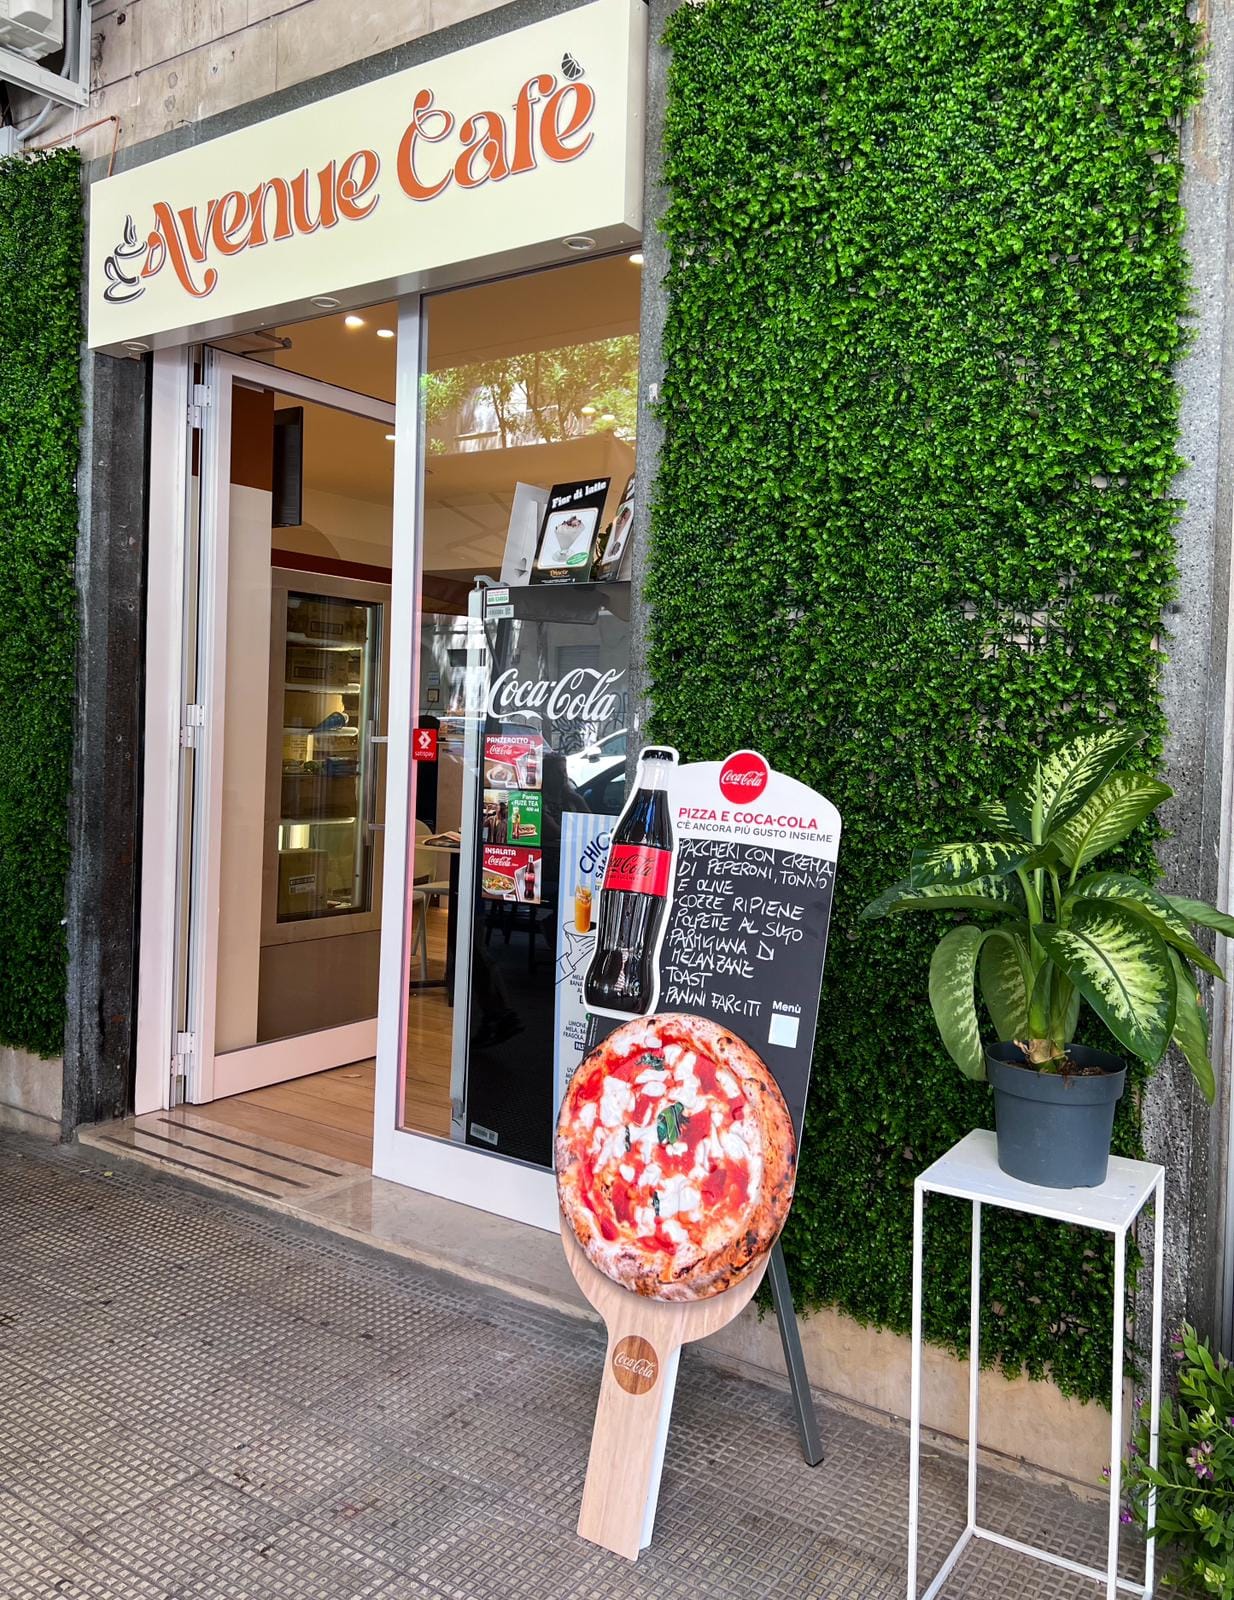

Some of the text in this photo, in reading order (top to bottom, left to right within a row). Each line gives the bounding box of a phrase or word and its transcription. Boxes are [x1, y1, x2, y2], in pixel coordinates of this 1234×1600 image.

[141, 149, 381, 299] Avenue
[551, 494, 572, 509] Fior
[573, 487, 583, 500] di
[487, 668, 626, 721] Coca-Cola
[721, 769, 767, 787] Coca-Cola
[678, 807, 717, 821] PIZZA
[720, 811, 730, 822] E
[692, 822, 732, 833] ANCORA
[734, 824, 751, 835] PIÙ
[752, 828, 787, 839] GUSTO
[789, 831, 833, 843] INSIEME
[485, 848, 516, 857] INSALATA
[744, 847, 776, 865] CON
[782, 853, 834, 877] CREMA
[677, 860, 698, 877] DI
[779, 870, 828, 889] TONNO
[677, 878, 735, 895] E OLIVE
[732, 896, 805, 921] RIPIENE
[738, 916, 759, 934] AL
[761, 921, 803, 945] SUGO
[671, 947, 754, 979] MELANZANE
[756, 940, 774, 961] DI
[711, 992, 762, 1017] FARCITI
[772, 1000, 802, 1014] Menù
[614, 1351, 656, 1378] Coca-Cola
